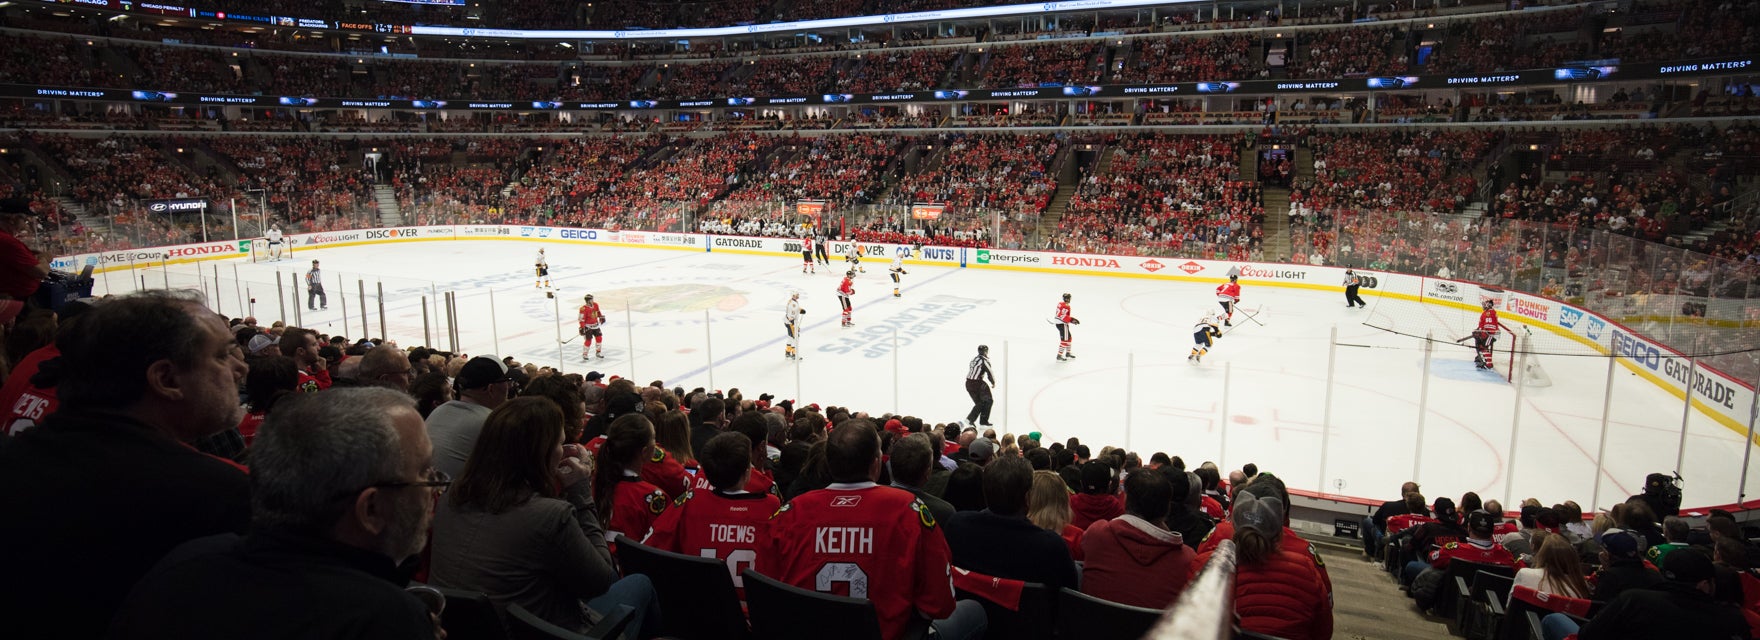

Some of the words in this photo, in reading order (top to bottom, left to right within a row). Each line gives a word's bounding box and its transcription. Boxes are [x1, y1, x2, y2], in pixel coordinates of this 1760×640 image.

[1661, 64, 1698, 74] DRIVING
[169, 202, 206, 210] HYUNDAI
[314, 234, 338, 243] Coors
[366, 228, 418, 239] DISCOVER
[560, 229, 597, 240] GEICO
[715, 238, 762, 248] GATORADE
[168, 244, 236, 257] HONDA
[835, 244, 884, 256] DISOVER
[924, 248, 954, 260] NUTS!
[980, 252, 1039, 263] enterprise
[1052, 256, 1121, 268] HONDA
[1240, 265, 1274, 278] Coors
[1276, 271, 1306, 280] LIGHT
[1520, 300, 1550, 312] DUNKIN'
[1518, 307, 1547, 320] DONUTS
[1561, 309, 1580, 326] SAP
[818, 302, 945, 355] PLAYOFFS
[864, 336, 913, 358] CUP
[1612, 330, 1660, 371] GEICO
[710, 524, 755, 543] TOEWS
[815, 526, 873, 554] KEITH
